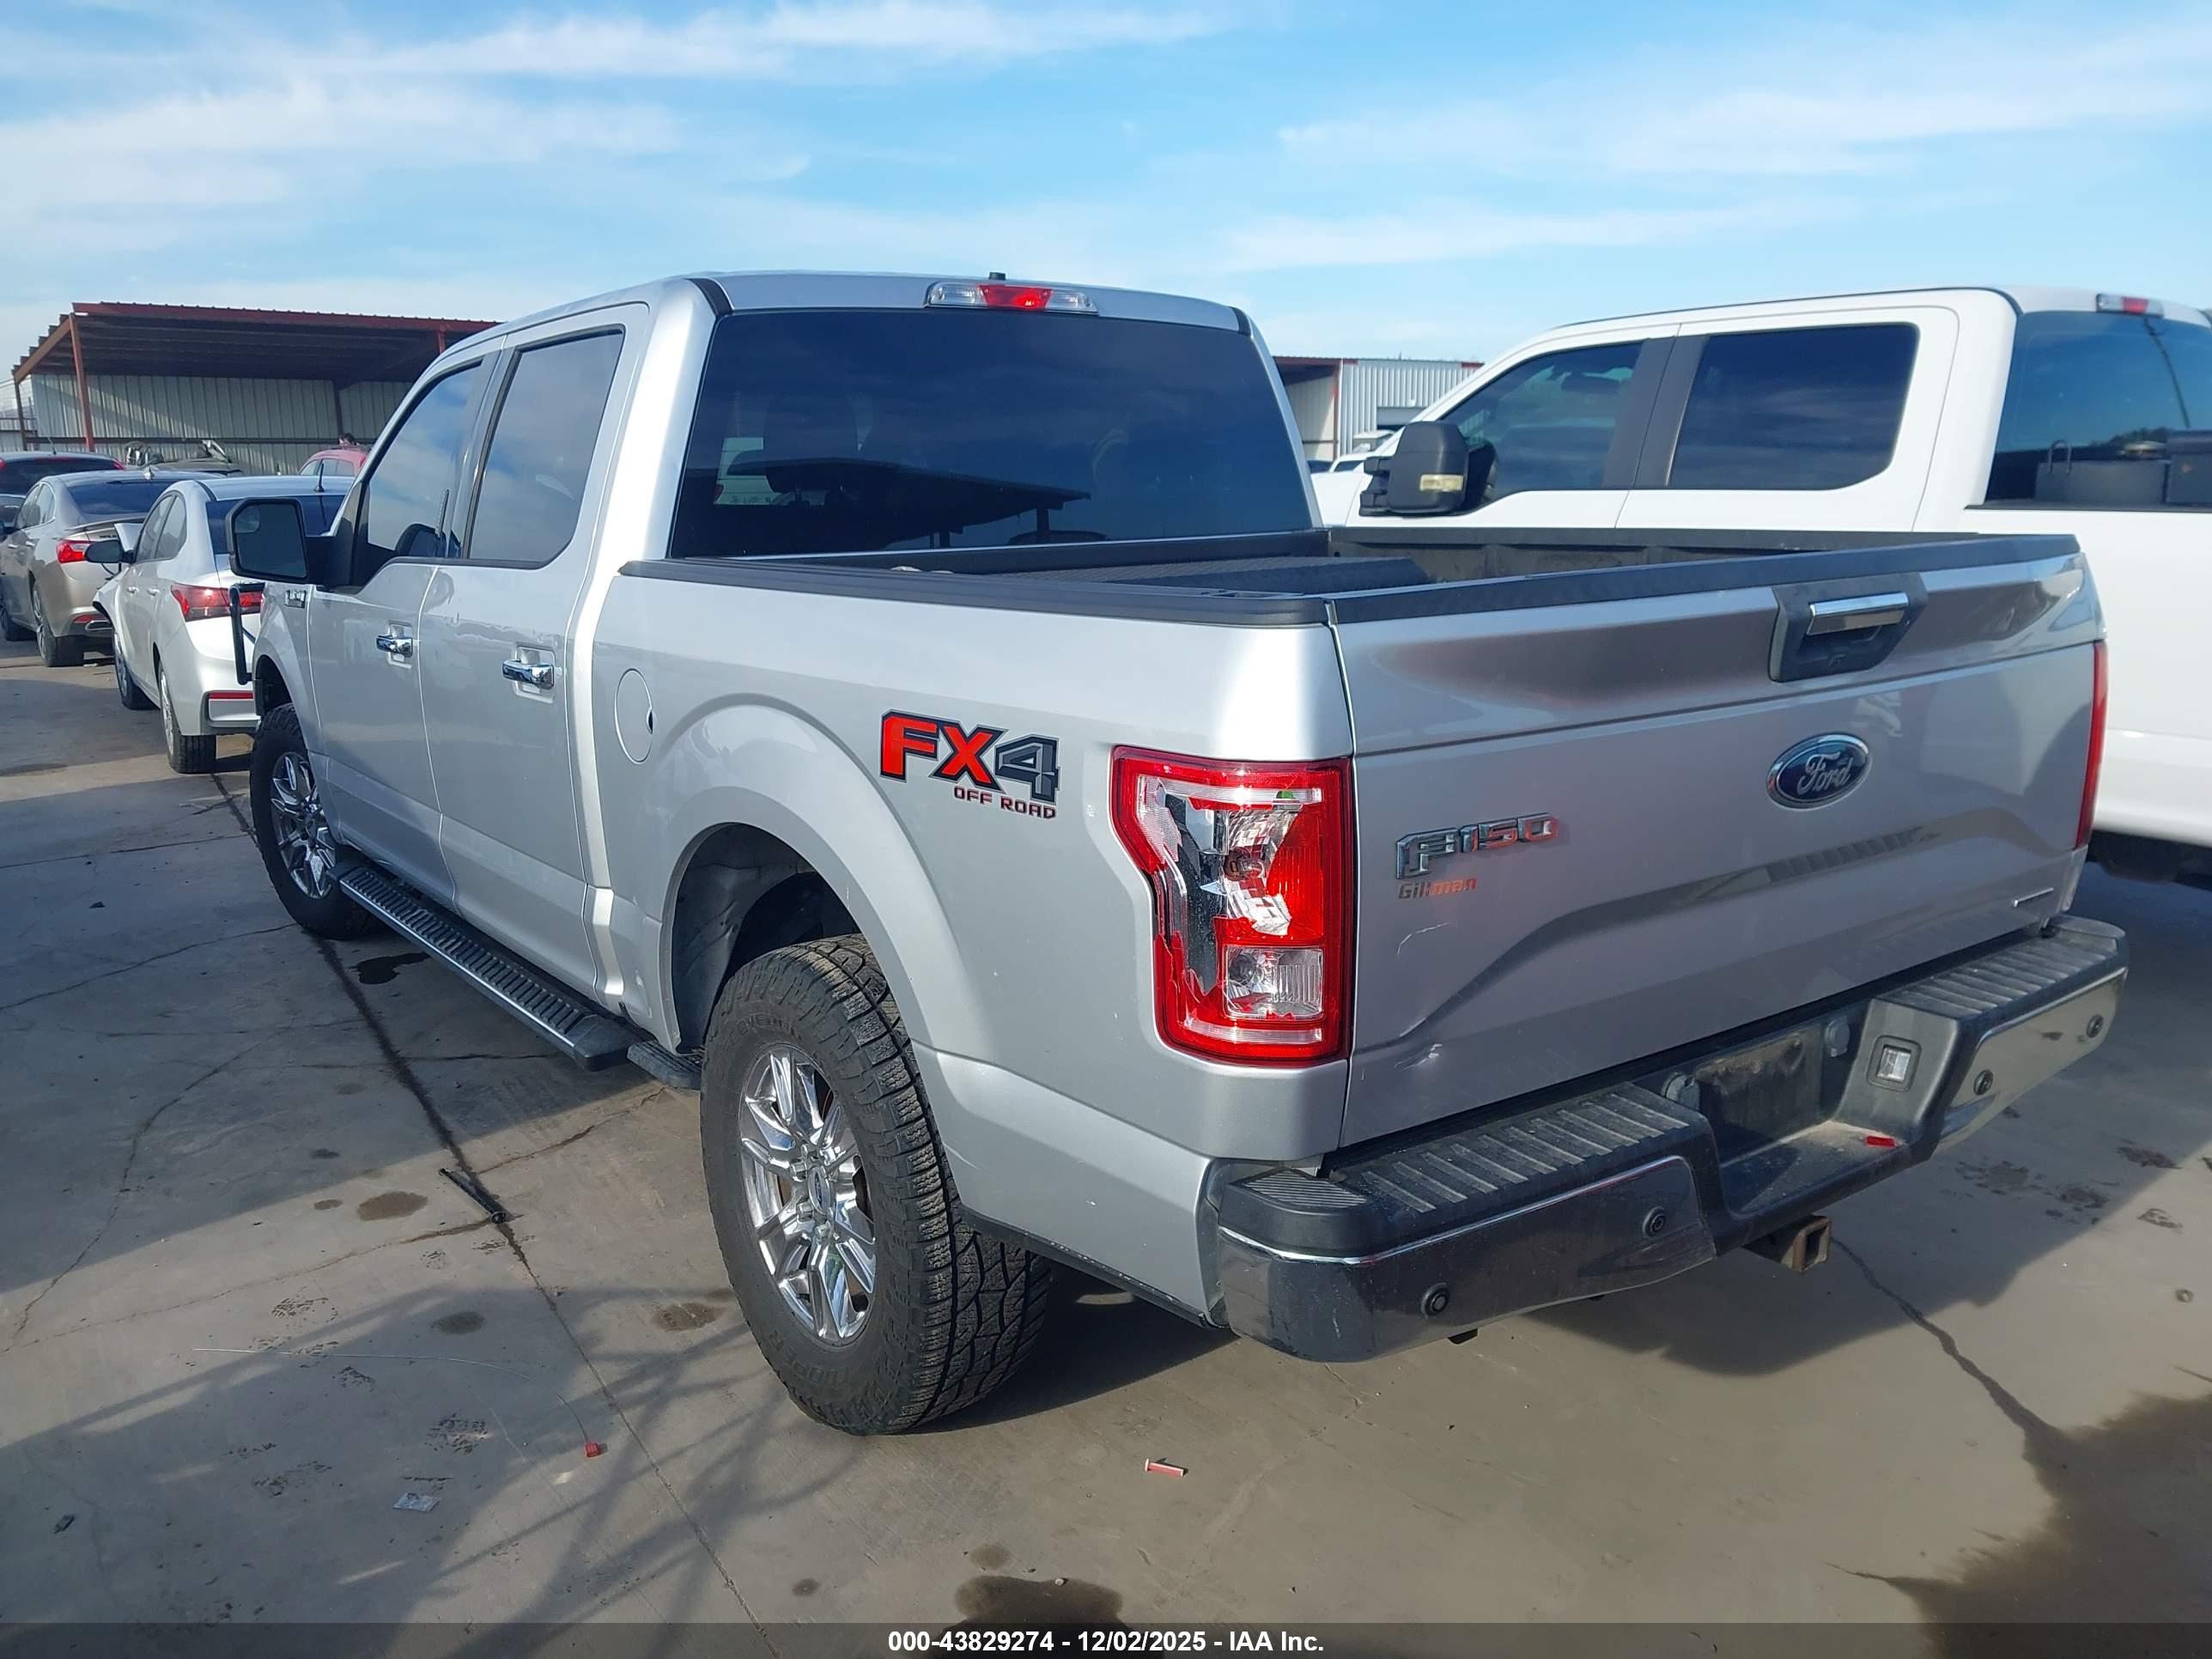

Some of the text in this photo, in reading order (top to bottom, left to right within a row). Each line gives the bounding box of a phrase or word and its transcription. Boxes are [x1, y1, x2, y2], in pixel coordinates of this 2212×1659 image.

[879, 708, 1061, 805] FX4
[1796, 750, 1854, 796] Ford
[953, 784, 1057, 820] OFF ROAD
[1398, 878, 1478, 900] Gillman
